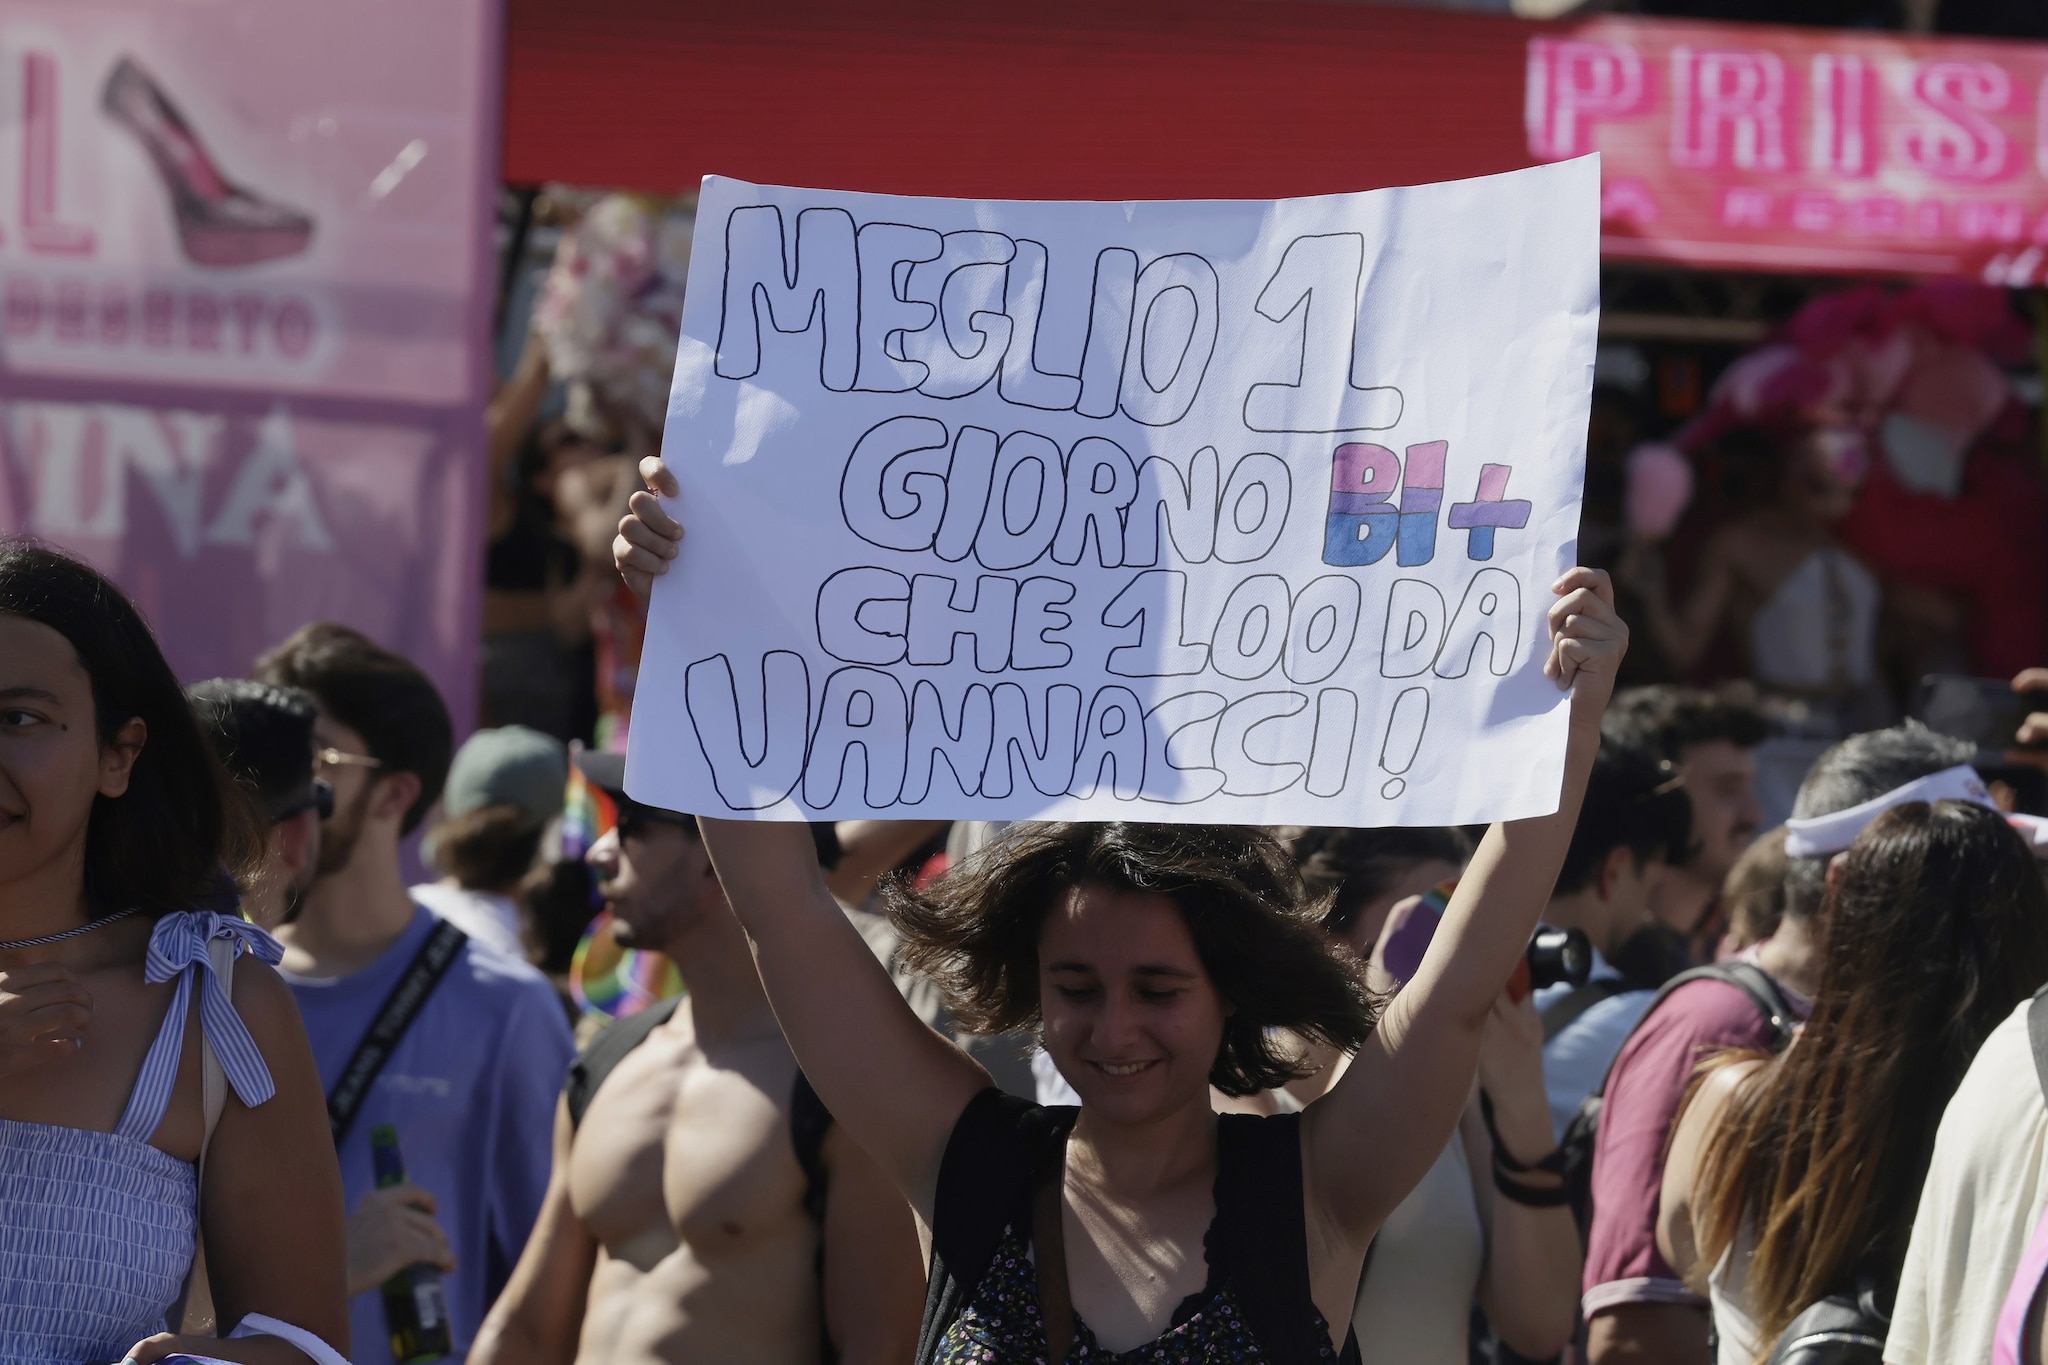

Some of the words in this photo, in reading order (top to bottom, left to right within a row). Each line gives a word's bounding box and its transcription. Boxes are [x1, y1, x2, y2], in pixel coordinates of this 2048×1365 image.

[1526, 38, 2048, 186] PRIS
[714, 204, 1220, 427] MEGLIO
[1243, 231, 1405, 433] 1
[839, 415, 1293, 571] GIORNO
[1321, 439, 1533, 567] BI+
[816, 565, 1076, 674] CHE
[1101, 568, 1362, 685] 100
[1380, 566, 1522, 679] DA
